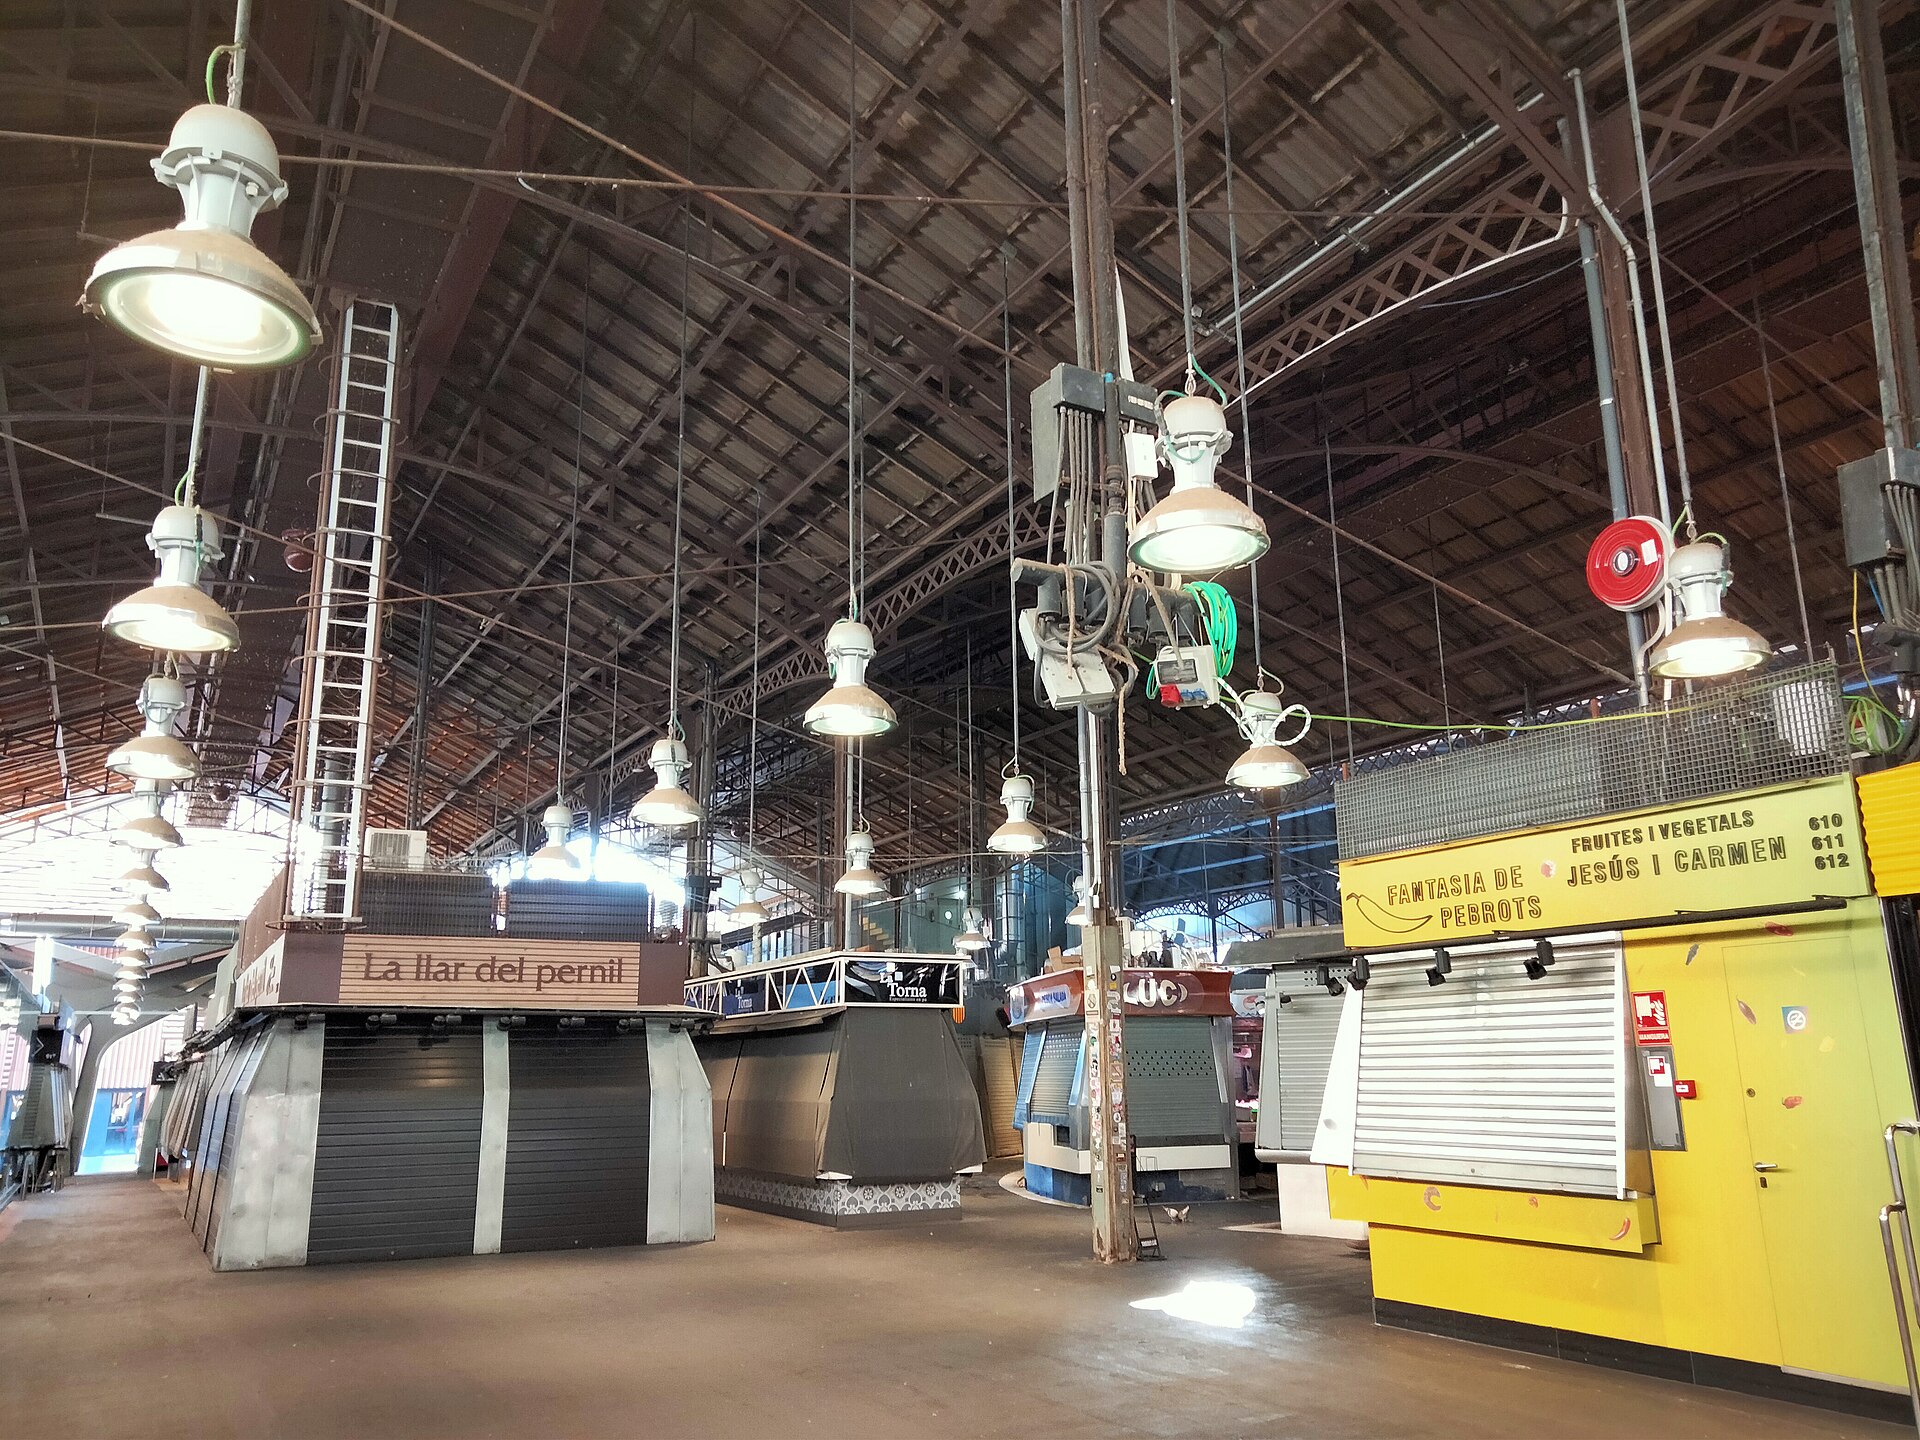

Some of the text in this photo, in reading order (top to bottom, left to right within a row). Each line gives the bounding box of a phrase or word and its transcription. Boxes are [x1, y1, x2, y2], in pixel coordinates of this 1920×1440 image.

[1571, 810, 1754, 853] FRUITES I VEGETALS
[1808, 813, 1843, 831] 610
[1811, 833, 1845, 851] 611
[1566, 836, 1787, 887] JESÚS I CARMEN
[1814, 853, 1850, 870] 612
[1387, 865, 1523, 906] FANTASIA DE
[1440, 895, 1542, 928] PEBROTS
[363, 953, 623, 991] La llar del pernil
[886, 982, 928, 998] Torna
